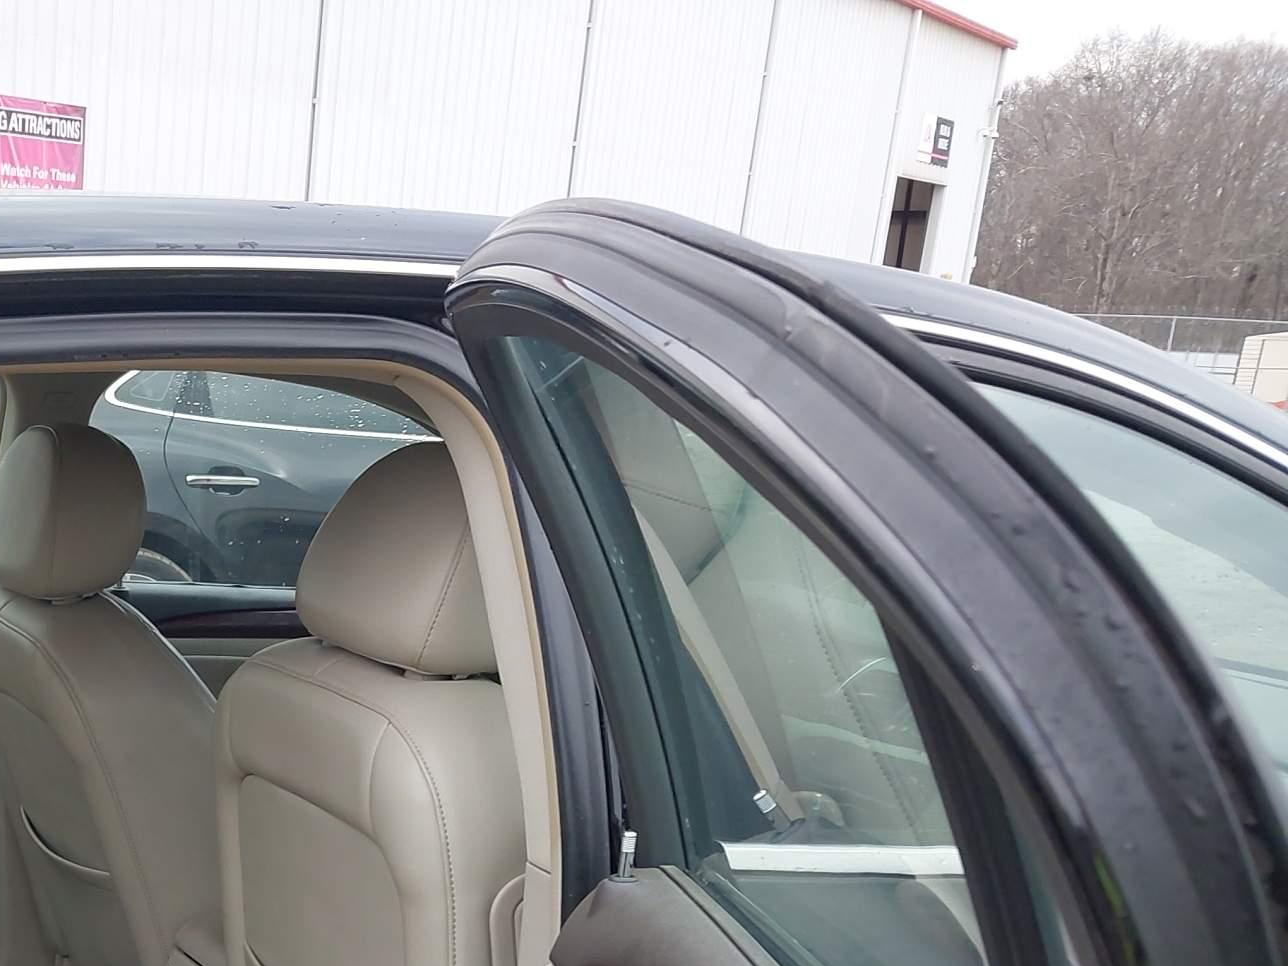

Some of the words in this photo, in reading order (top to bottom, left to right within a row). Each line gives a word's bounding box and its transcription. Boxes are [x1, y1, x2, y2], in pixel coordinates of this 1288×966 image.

[8, 112, 80, 139] ATTRACTIONS
[1, 162, 31, 178] Watch
[32, 165, 48, 180] For
[50, 167, 76, 183] These
